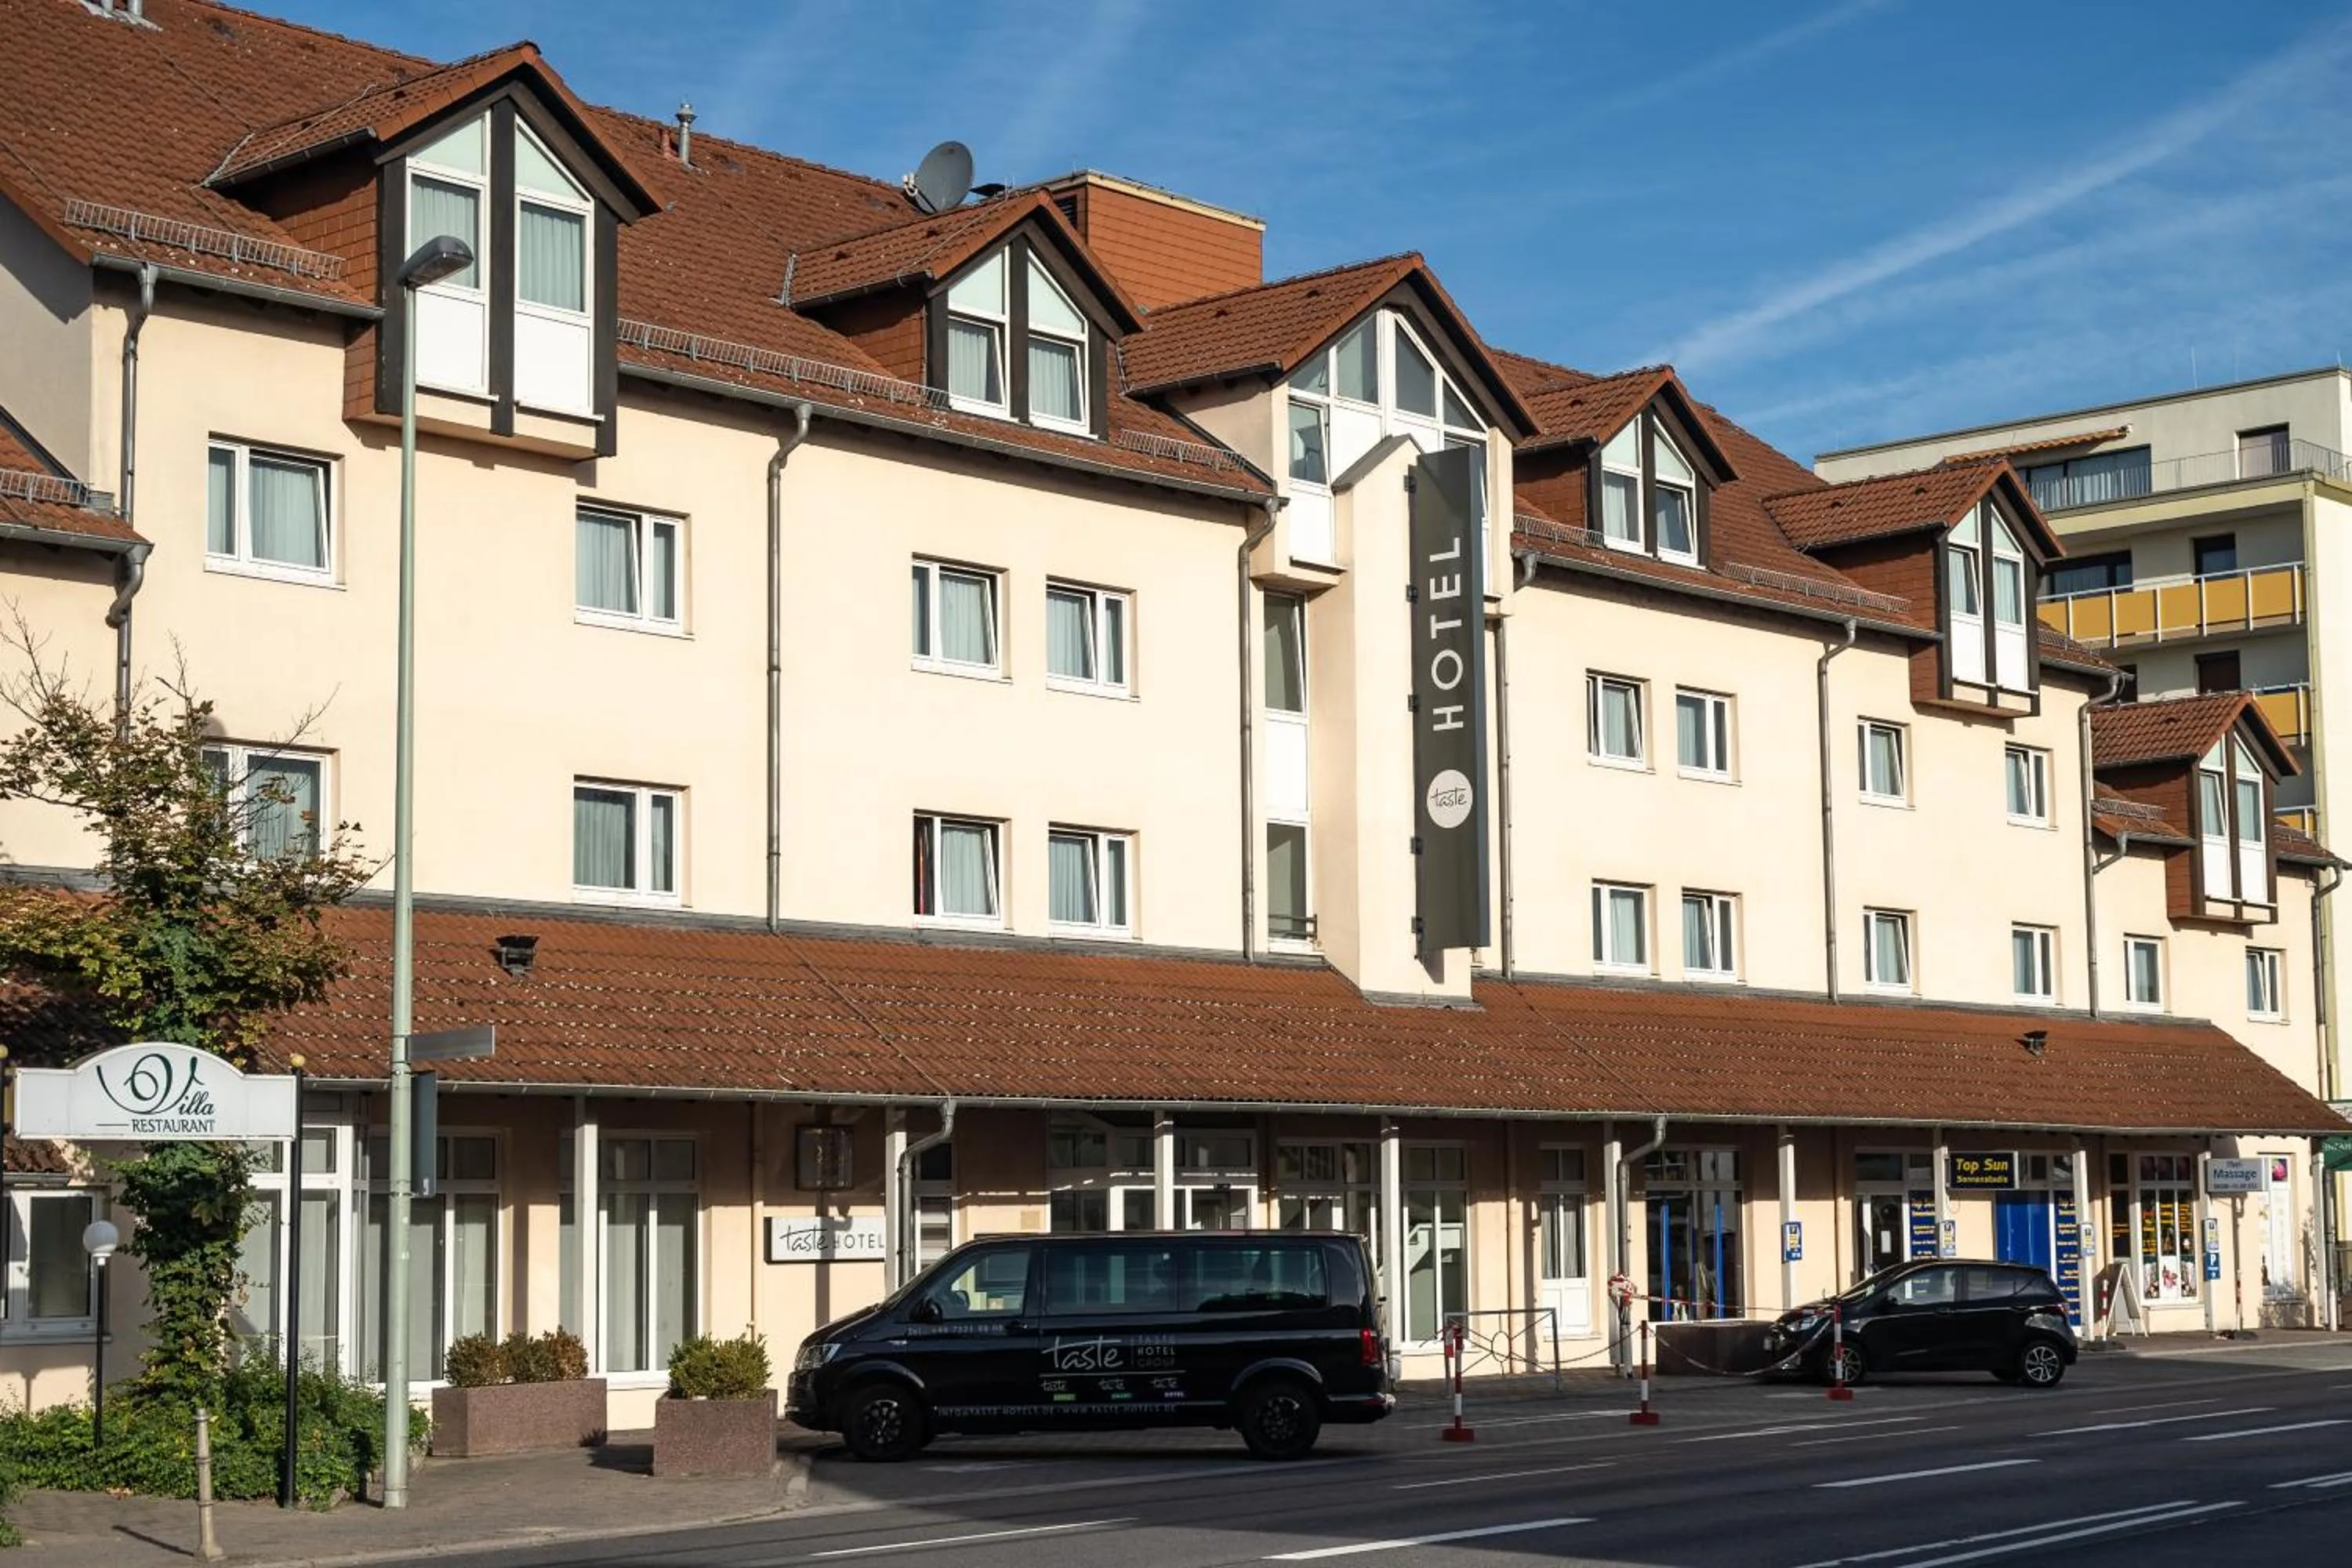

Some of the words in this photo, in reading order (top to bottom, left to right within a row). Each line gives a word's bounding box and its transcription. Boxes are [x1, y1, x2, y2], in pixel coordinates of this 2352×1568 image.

[1429, 537, 1465, 731] HOTEL
[1430, 787, 1467, 807] taste
[96, 1053, 216, 1116] Villa
[131, 1118, 216, 1134] RESTAURANT
[1955, 1158, 1980, 1174] Top
[1983, 1157, 2009, 1172] Sun
[2212, 1168, 2257, 1181] Massage
[779, 1225, 829, 1252] taste
[833, 1233, 885, 1249] HOTEL
[1040, 1335, 1123, 1370] taste
[1137, 1346, 1176, 1356] HOTEL
[1137, 1357, 1176, 1367] GROUP
